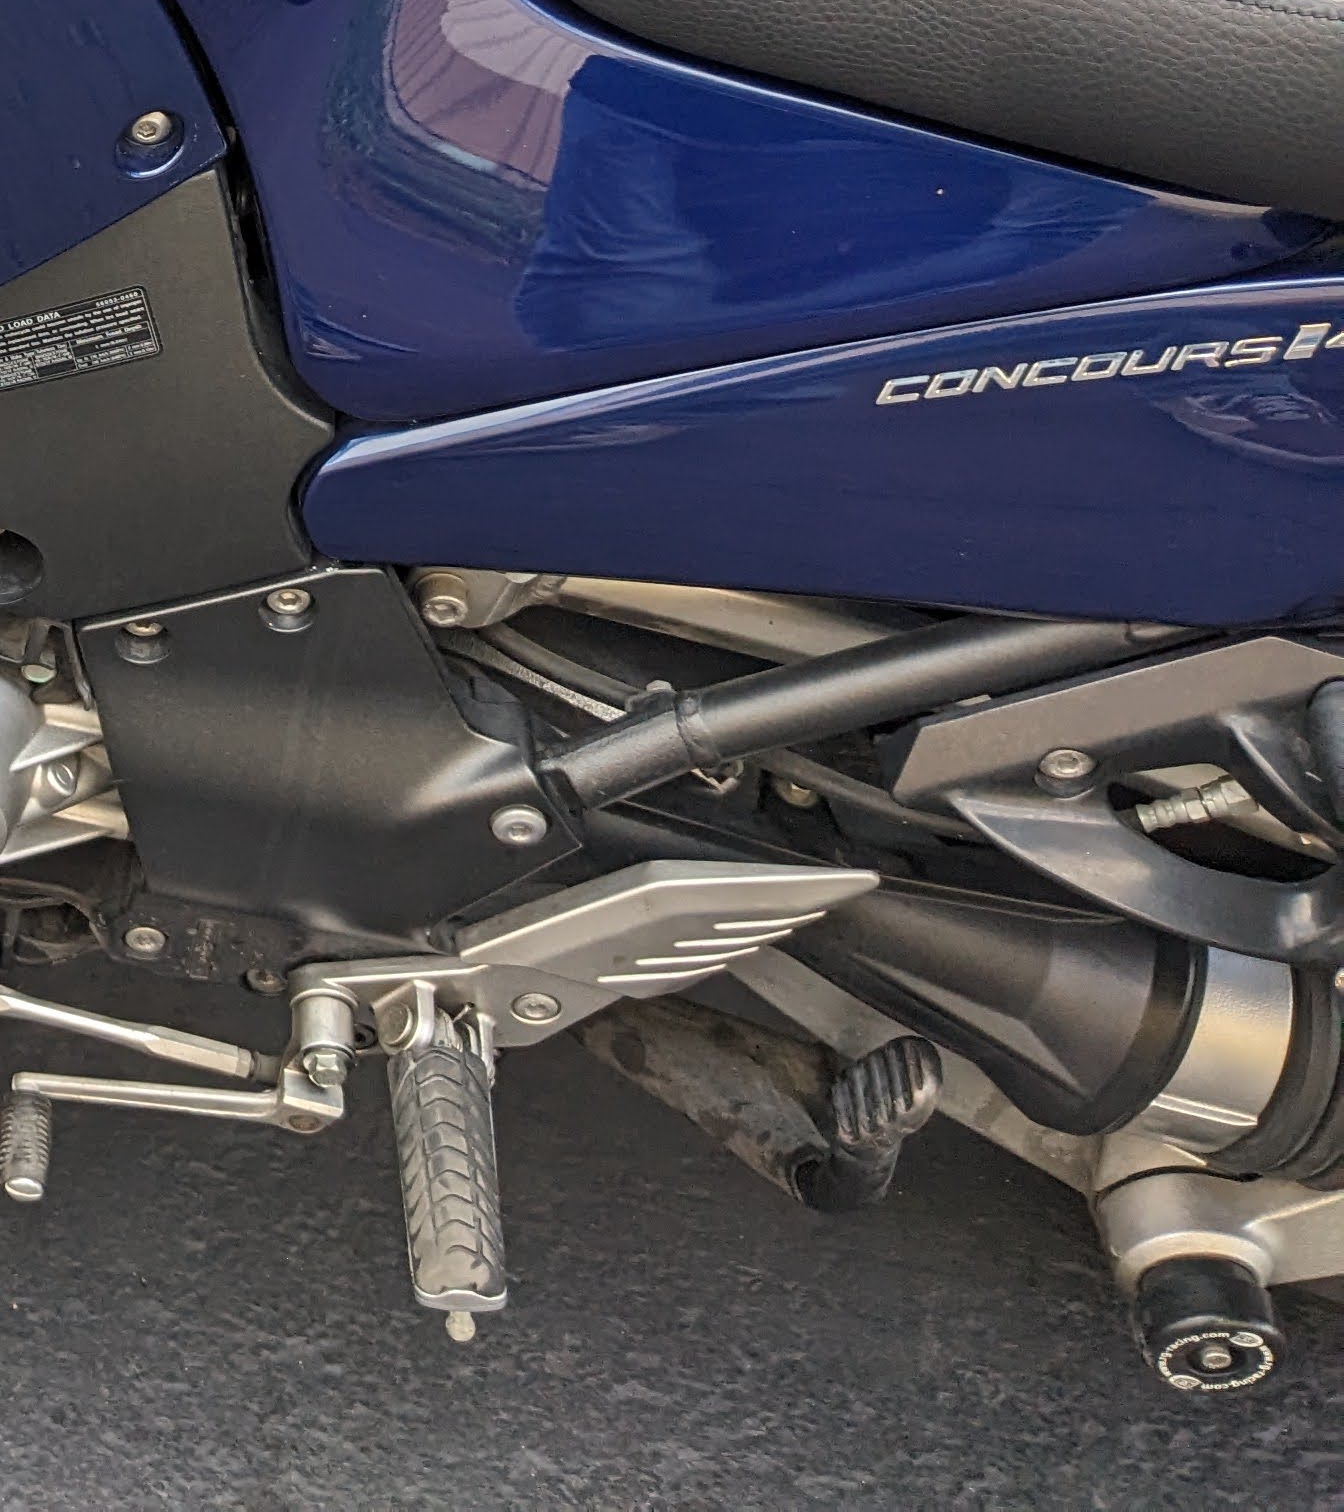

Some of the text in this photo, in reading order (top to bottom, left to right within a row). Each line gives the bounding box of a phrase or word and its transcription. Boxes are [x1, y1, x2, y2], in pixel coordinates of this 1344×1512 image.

[7, 318, 34, 330] LOAD
[36, 311, 61, 323] DATA
[875, 335, 1283, 406] CONCOURS
